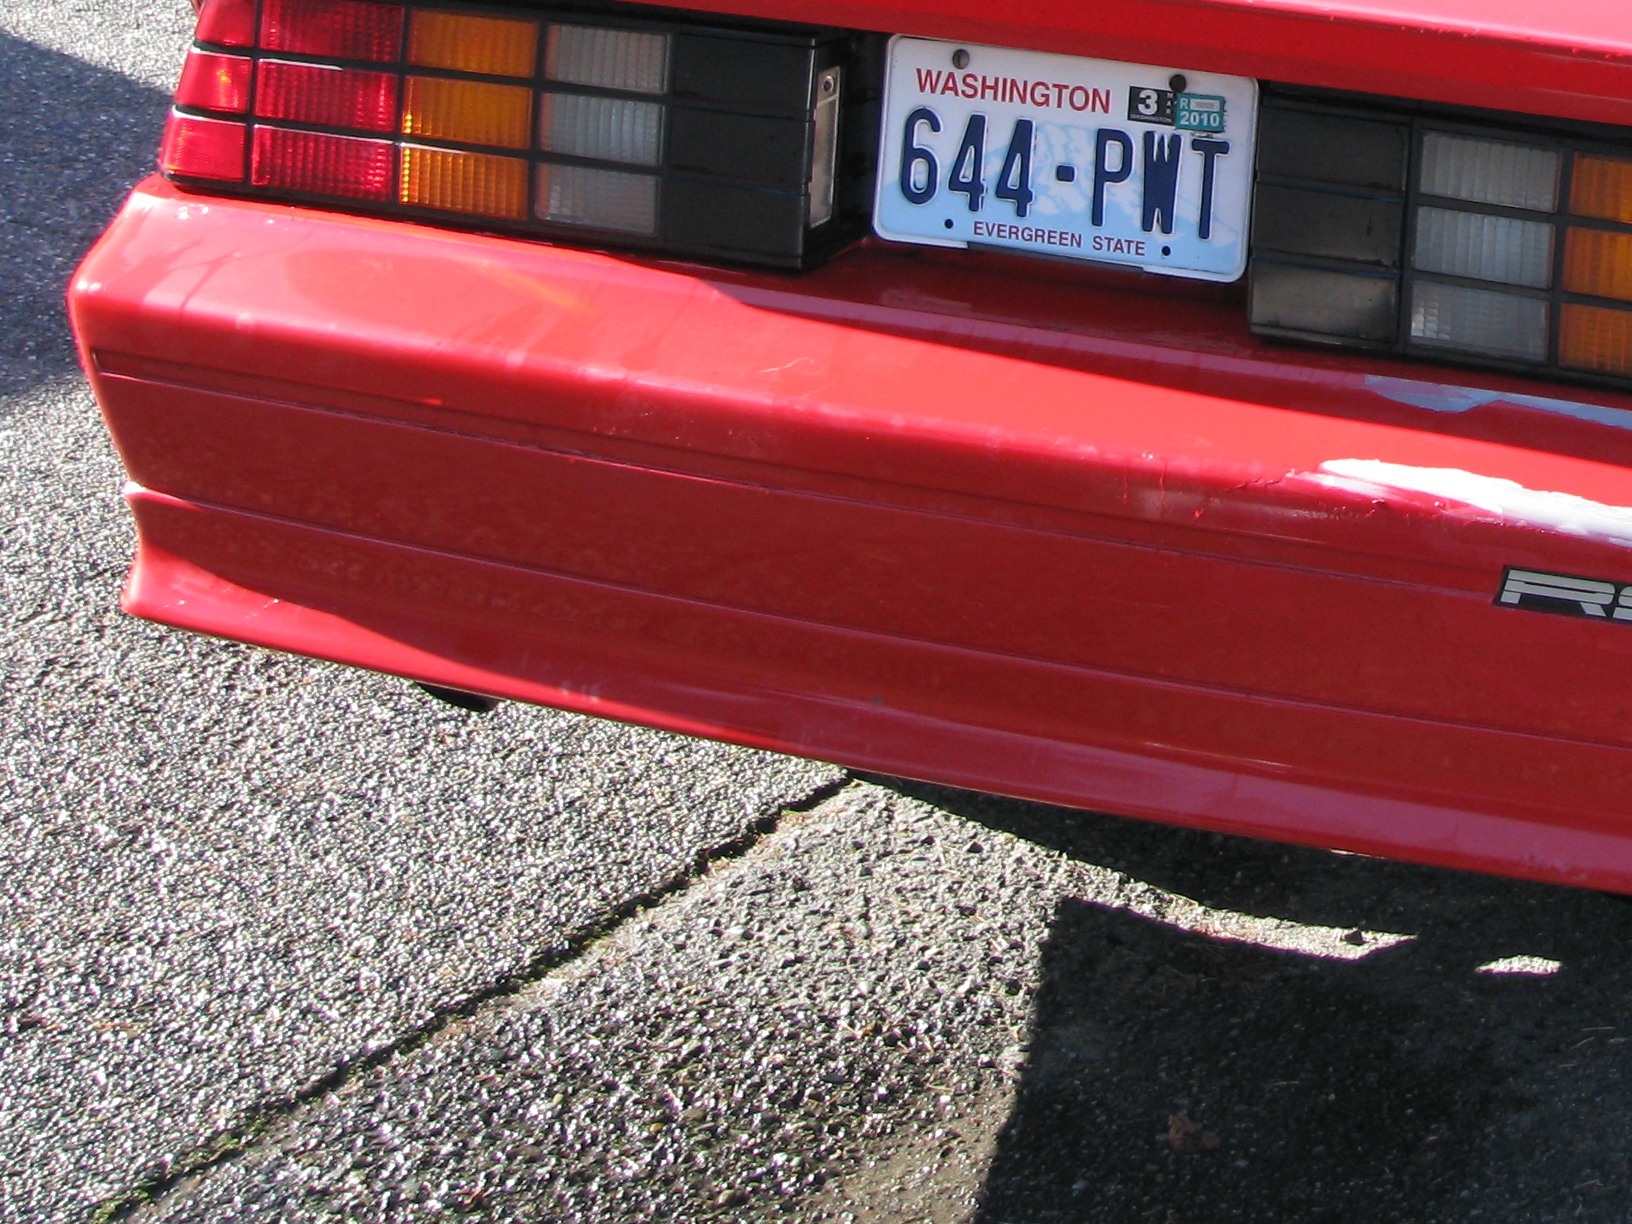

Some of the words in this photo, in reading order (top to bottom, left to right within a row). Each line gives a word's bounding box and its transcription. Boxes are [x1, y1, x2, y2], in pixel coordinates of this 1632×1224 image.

[915, 68, 1112, 114] WASHINGTON
[1138, 89, 1158, 115] 3
[1179, 111, 1220, 127] 2010
[900, 106, 1231, 240] 644-PWT
[972, 221, 1083, 249] EVERGREEN
[1092, 235, 1146, 257] STATE
